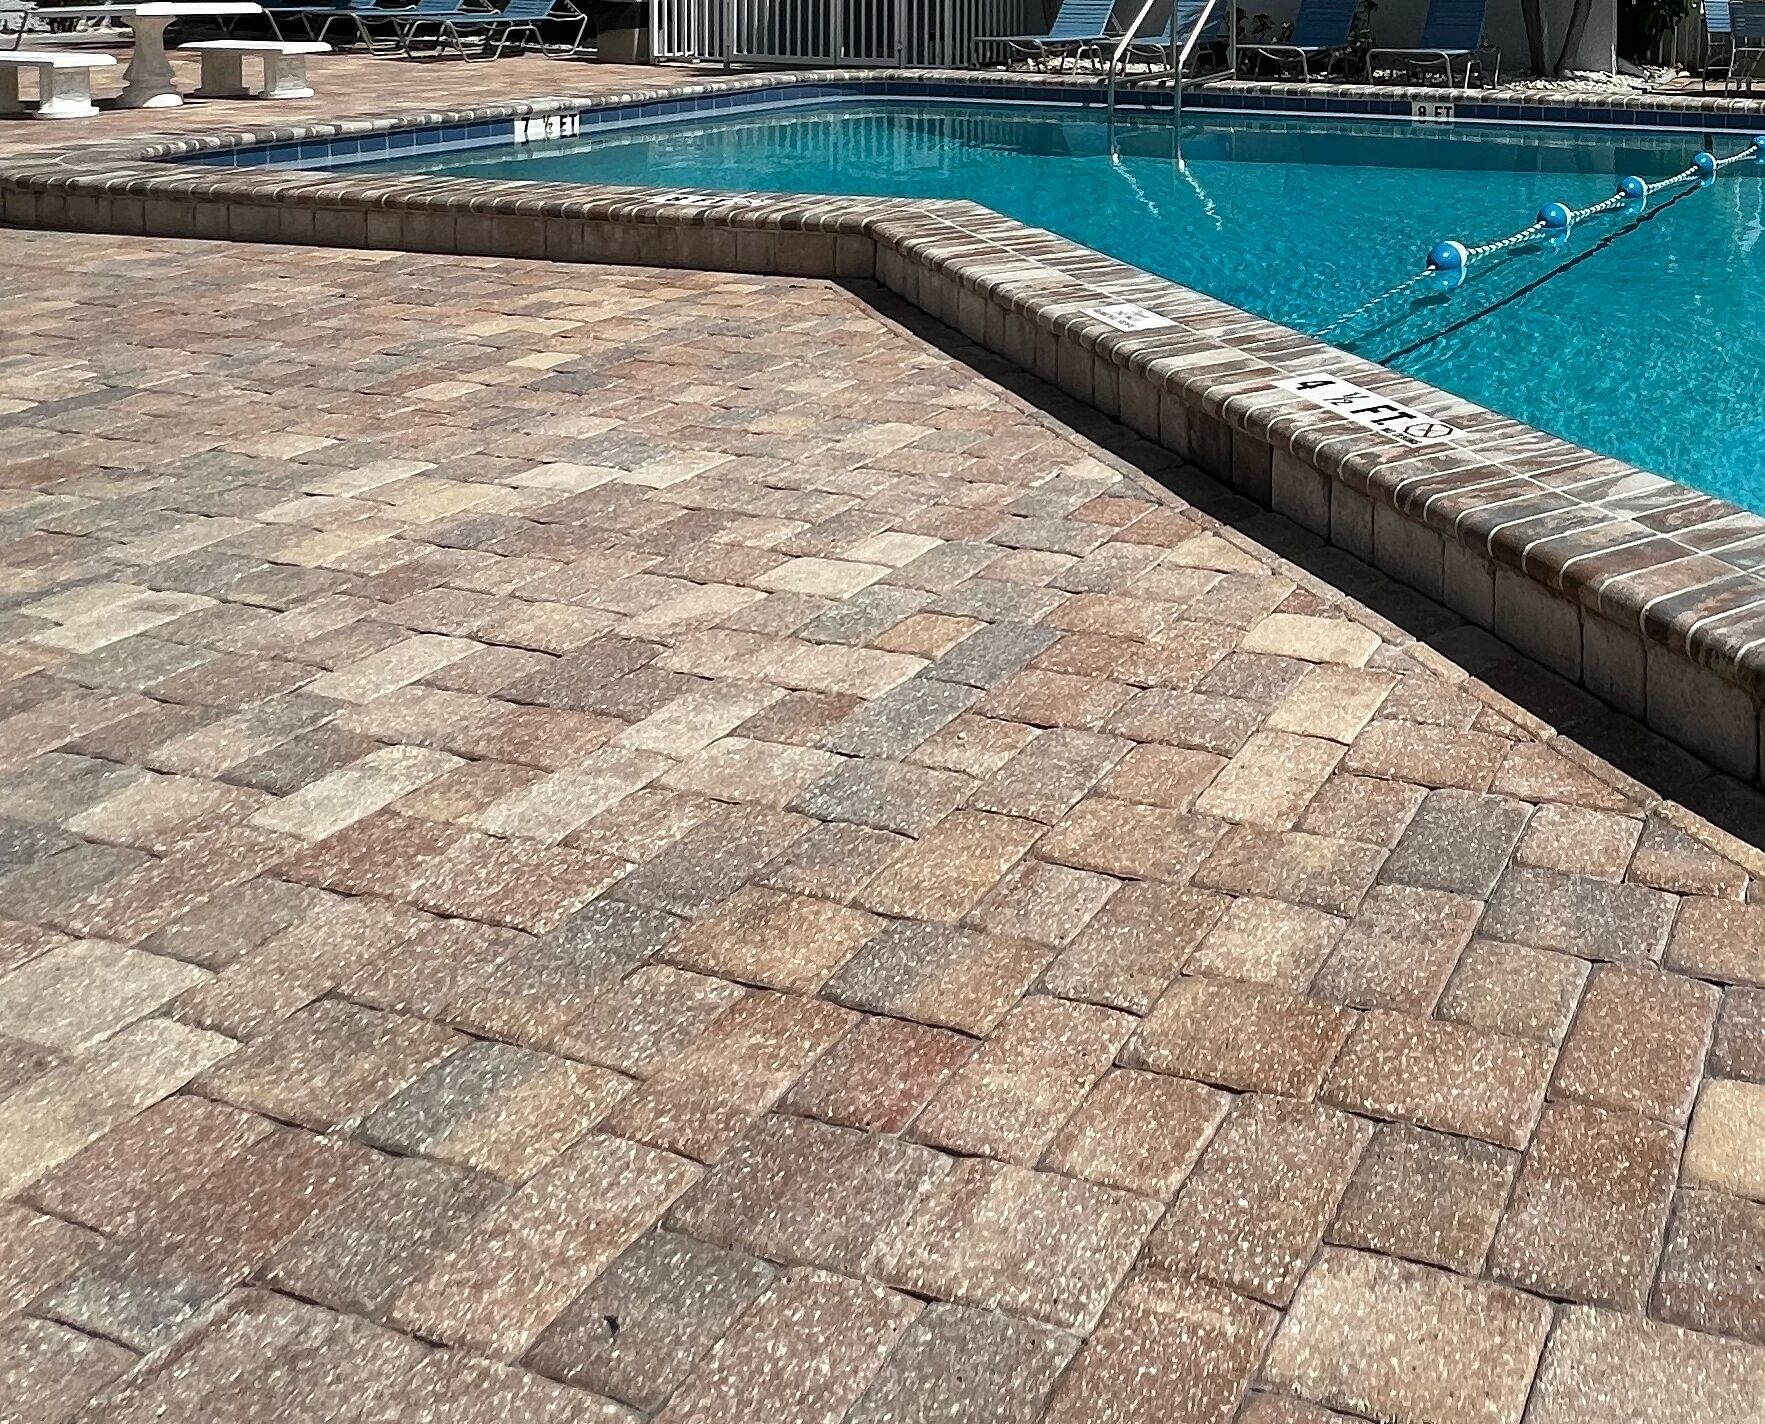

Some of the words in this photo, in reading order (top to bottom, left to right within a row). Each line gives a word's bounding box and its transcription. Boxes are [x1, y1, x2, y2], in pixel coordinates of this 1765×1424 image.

[1434, 106, 1452, 117] FT
[521, 117, 530, 133] 7
[560, 114, 578, 132] FT
[1296, 380, 1336, 390] 4
